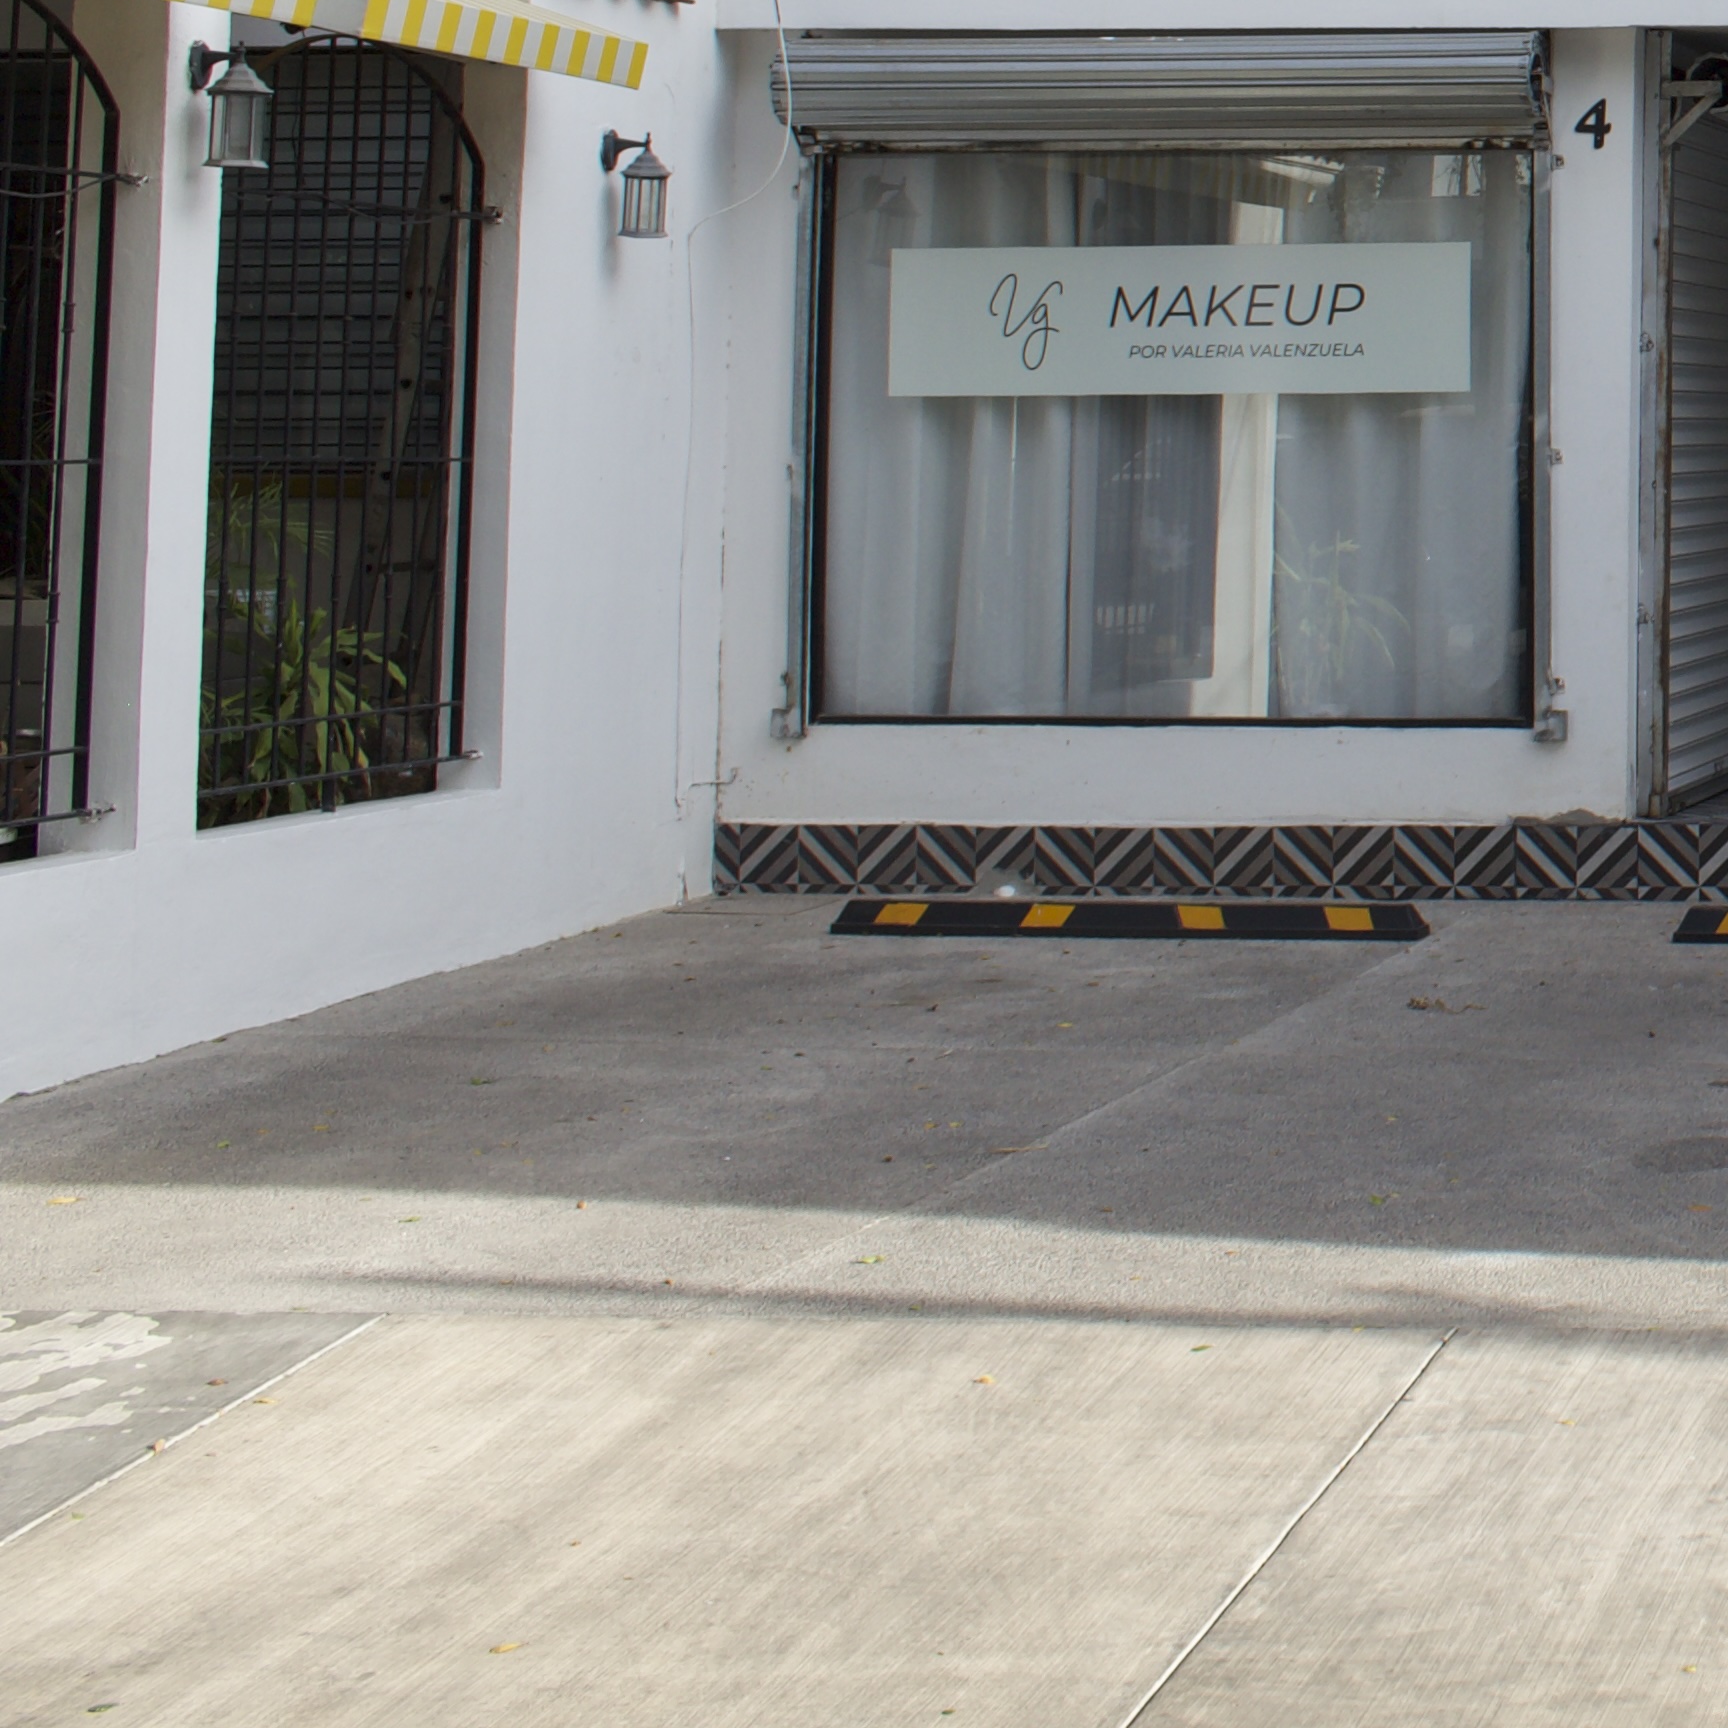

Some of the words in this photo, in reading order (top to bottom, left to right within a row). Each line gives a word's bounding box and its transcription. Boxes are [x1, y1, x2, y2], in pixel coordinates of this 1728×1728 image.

[1574, 98, 1612, 150] 4
[1108, 282, 1366, 328] MAKEUP
[1128, 344, 1168, 359] POR
[1171, 342, 1245, 359] VALERIA
[1249, 341, 1366, 359] VALENZUELA
